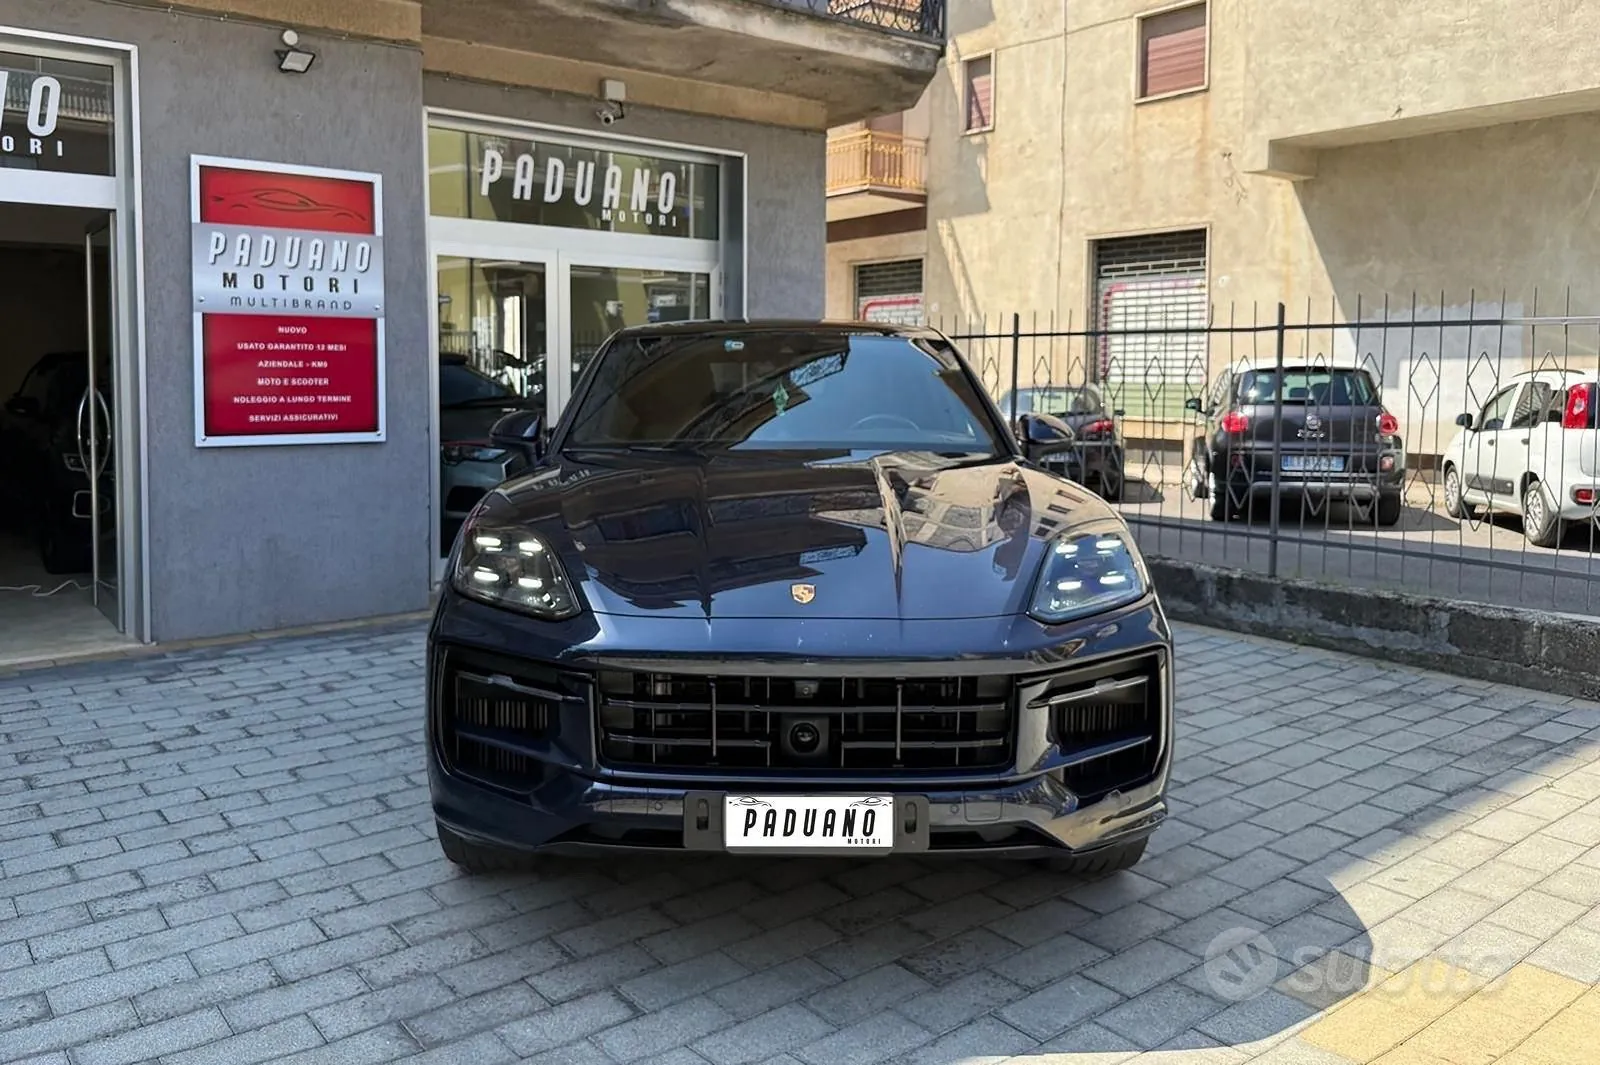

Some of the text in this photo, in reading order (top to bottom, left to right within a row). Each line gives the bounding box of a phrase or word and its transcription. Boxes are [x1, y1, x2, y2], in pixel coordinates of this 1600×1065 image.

[0, 71, 61, 136] O
[480, 149, 676, 214] PADUANO
[601, 209, 677, 227] MOTORI
[208, 231, 372, 272] PADUANO
[222, 272, 359, 293] MOTORI
[230, 296, 352, 311] MULTIBRAND
[278, 326, 307, 334] NUOVO
[237, 342, 347, 352] USATO GARANTITO 12 MESI
[258, 360, 304, 368] AZIENDALE
[257, 378, 329, 386] MOTO E SCOOTER
[287, 395, 316, 403] LUNGO
[249, 413, 338, 422] SERVIZI ASSICURATIVI
[743, 808, 876, 837] PADUANO
